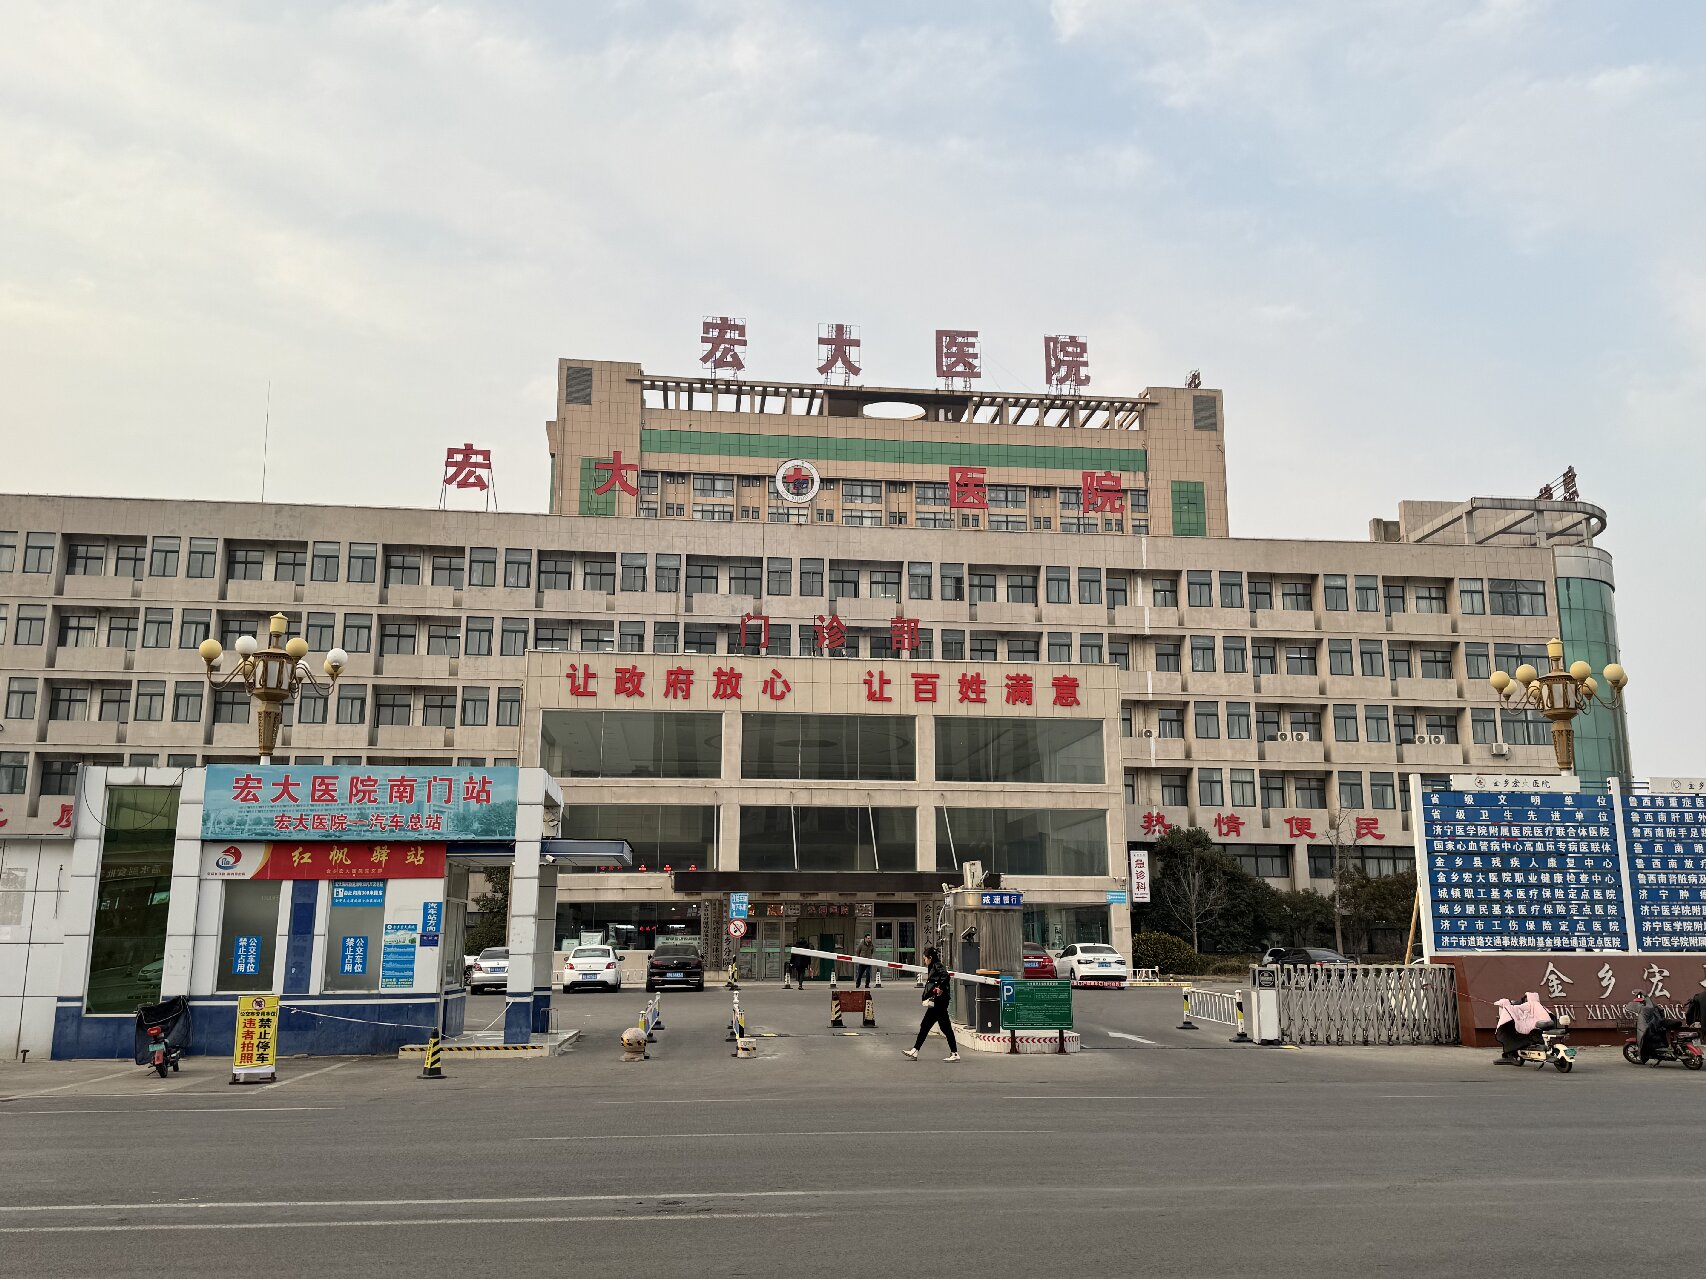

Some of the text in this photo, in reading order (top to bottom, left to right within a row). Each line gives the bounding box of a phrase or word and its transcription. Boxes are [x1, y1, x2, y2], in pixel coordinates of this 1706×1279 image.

[699, 317, 1091, 387] 宏大医院
[740, 613, 920, 653] 门诊部
[565, 663, 1081, 708] 让政府放心 让百姓满意
[231, 774, 493, 804] 宏大医院南门站
[1493, 779, 1551, 789] 金乡宏大医院
[1430, 794, 1607, 807] 省级文明单位
[1140, 811, 1386, 840] 热情便民
[1431, 809, 1608, 822] 省级卫生先进单位
[1432, 825, 1610, 838] 济宁医学院附属医院医疗联合体医院
[291, 846, 424, 867] 红帆驿站
[1434, 856, 1613, 868] 金乡县残疾人康复中心
[1634, 843, 1704, 854] 鲁西南眼
[1135, 859, 1146, 892] 急诊科
[1437, 872, 1616, 884] 金乡宏大医院职业健康检查中心
[1438, 888, 1617, 900] 城镇职工基本医疗保险定点医院
[427, 902, 438, 932] 汽车站方向
[1438, 904, 1618, 916] 城乡居民基本医疗保险定点医院
[1440, 920, 1620, 932] 济宁市工伤保险定点医院
[1642, 921, 1706, 932] 济宁医学院附
[235, 937, 247, 973] 禁止占用
[247, 938, 259, 973] 公交车位
[343, 937, 355, 973] 禁止占用
[354, 938, 364, 973] 公交车位
[1003, 985, 1014, 1001] P
[1540, 961, 1706, 999] 金乡宏
[239, 1017, 256, 1064] 违者拍照
[255, 1017, 272, 1064] 禁止停车
